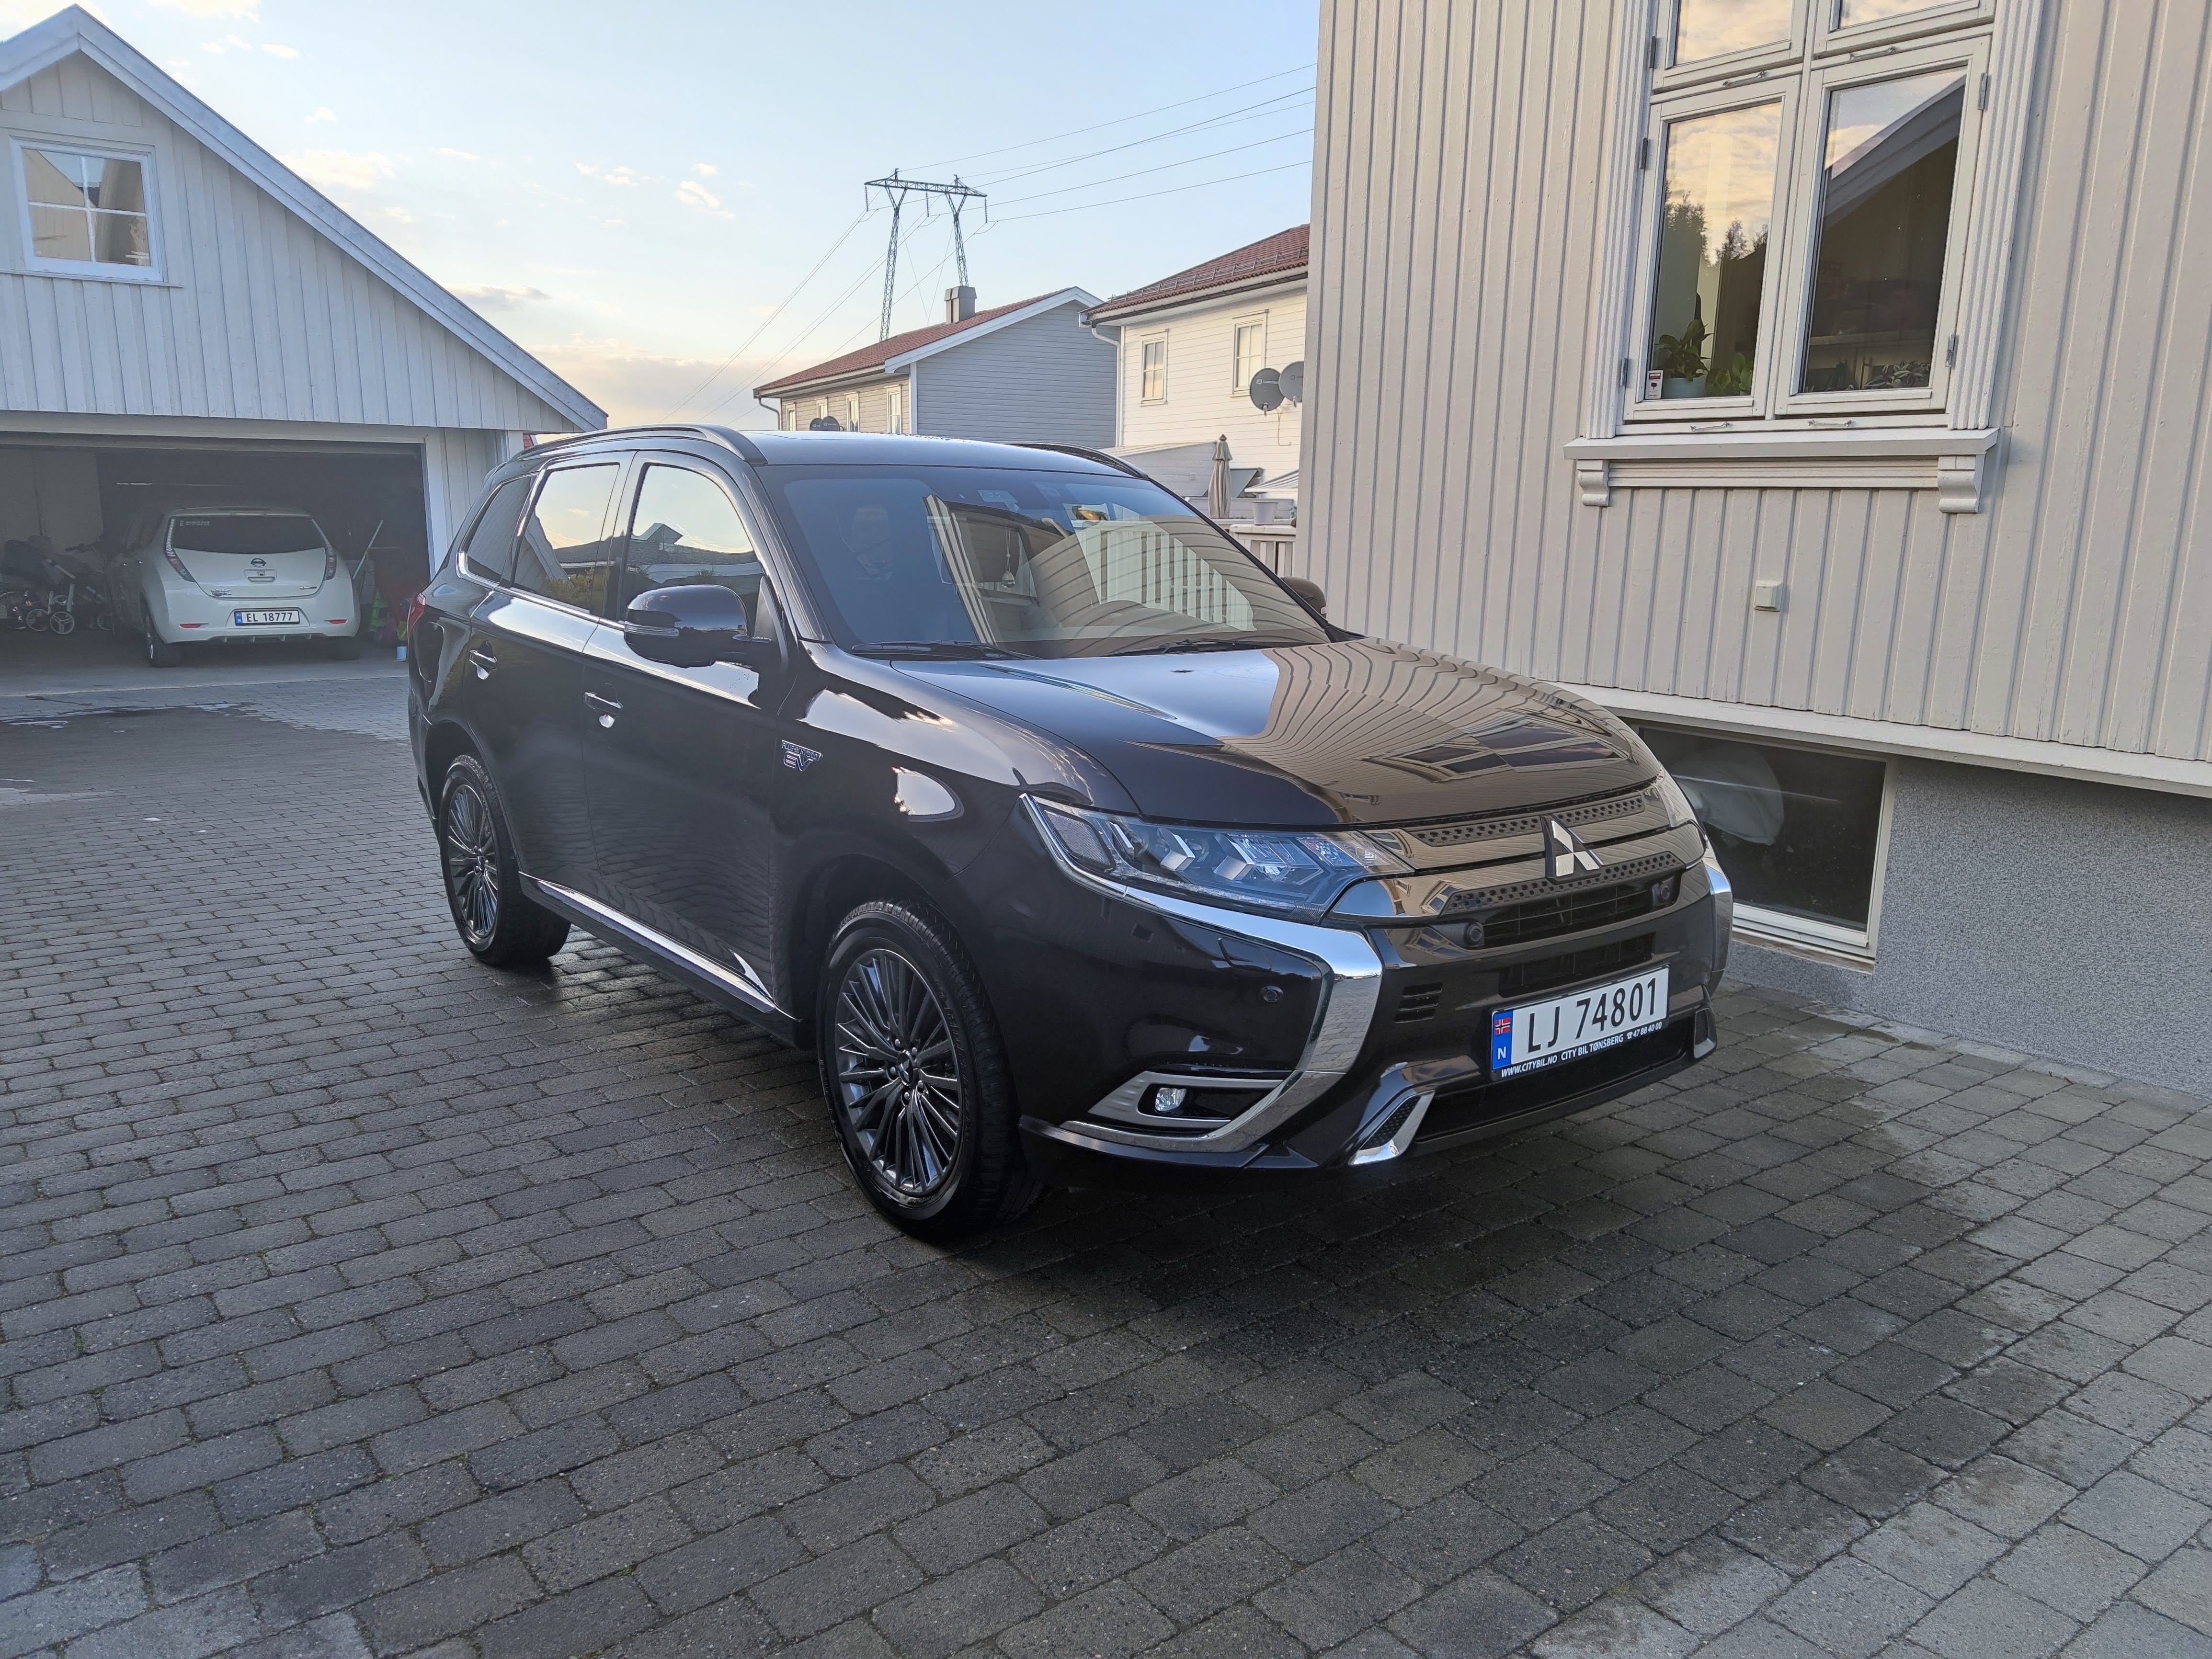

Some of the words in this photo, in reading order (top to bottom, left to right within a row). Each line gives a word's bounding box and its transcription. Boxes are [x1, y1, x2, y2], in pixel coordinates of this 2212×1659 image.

[246, 613, 258, 622] EL
[262, 612, 293, 622] 18777
[1528, 1006, 1560, 1053] LJ
[1576, 977, 1656, 1038] 74801
[1497, 1046, 1506, 1060] N
[1501, 1055, 1558, 1078] WWW.CITYBIL.NO
[1561, 1048, 1577, 1061] CITY
[1578, 1044, 1588, 1057] BIL
[1589, 1034, 1624, 1052] TØNSBERG
[1633, 1029, 1640, 1038] 47
[1640, 1026, 1648, 1035] 88
[1648, 1024, 1655, 1033] 40
[1655, 1021, 1662, 1030] 00
